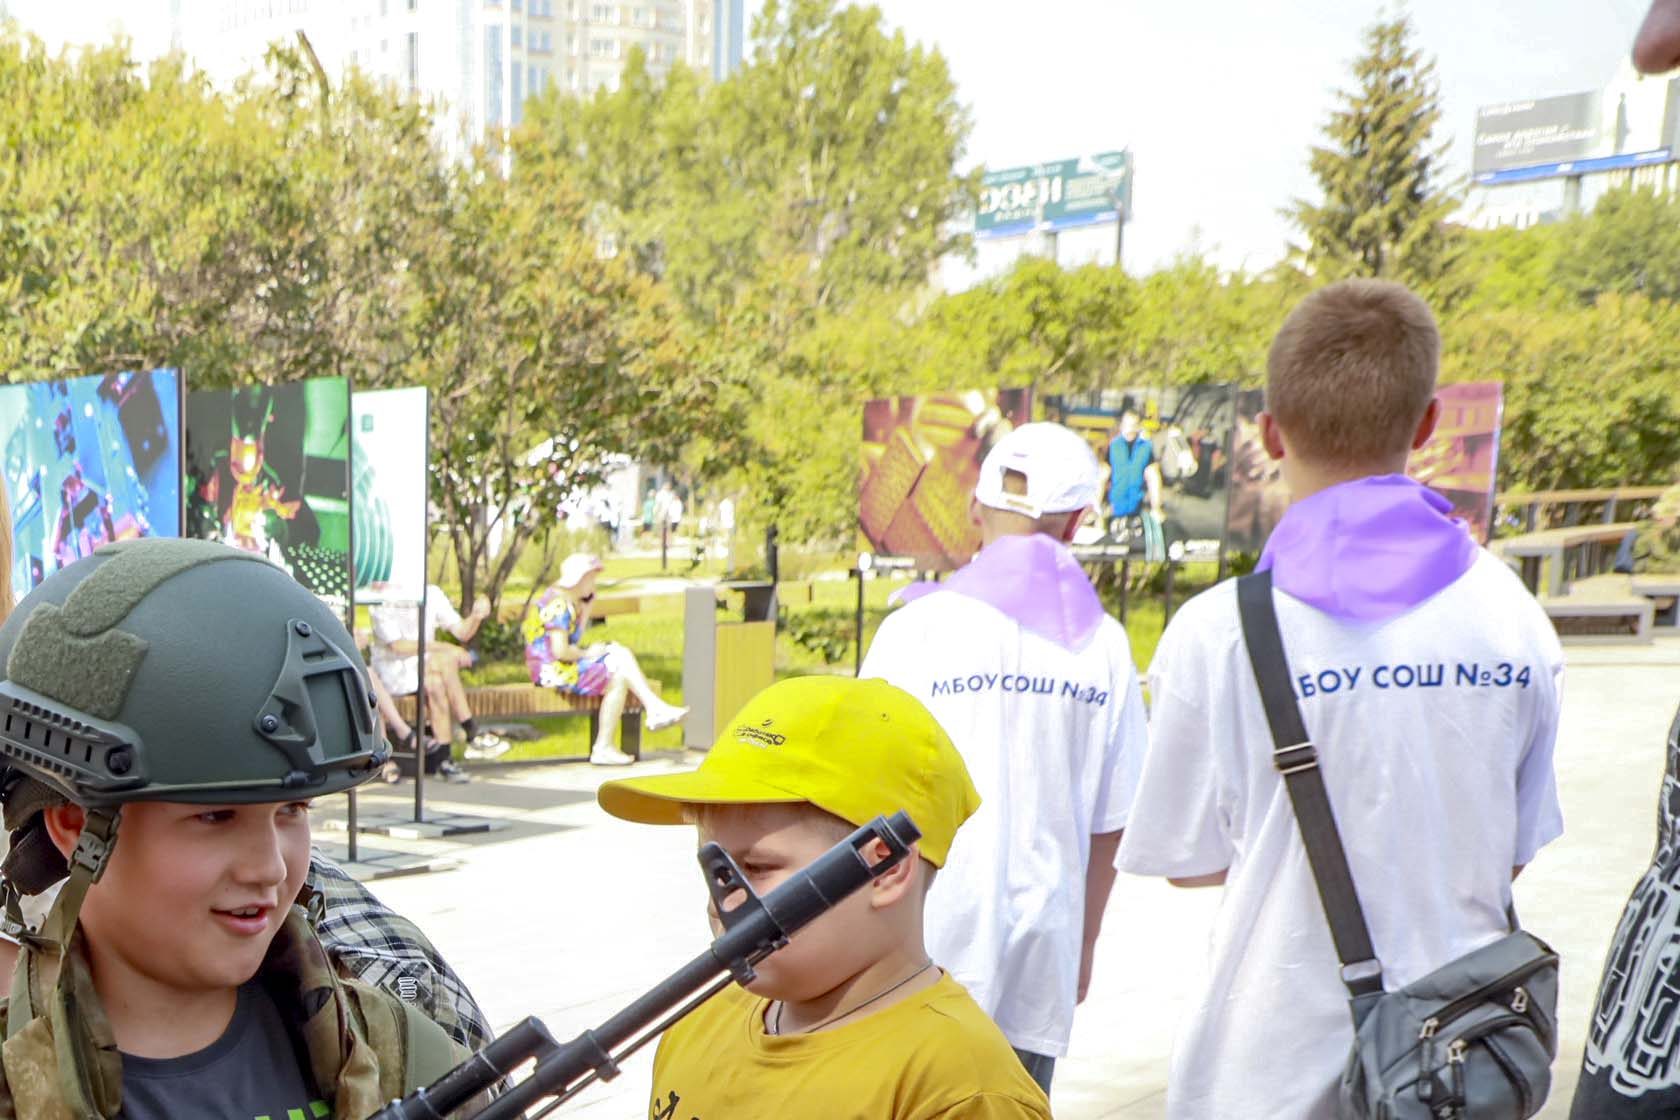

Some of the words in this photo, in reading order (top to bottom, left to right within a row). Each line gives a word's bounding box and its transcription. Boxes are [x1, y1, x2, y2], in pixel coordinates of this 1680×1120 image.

[932, 673, 998, 697] МБОУ
[1001, 674, 1055, 694] СОШ
[1296, 667, 1361, 699] БОУ
[1372, 664, 1444, 688] СОШ
[1456, 662, 1531, 689] №34
